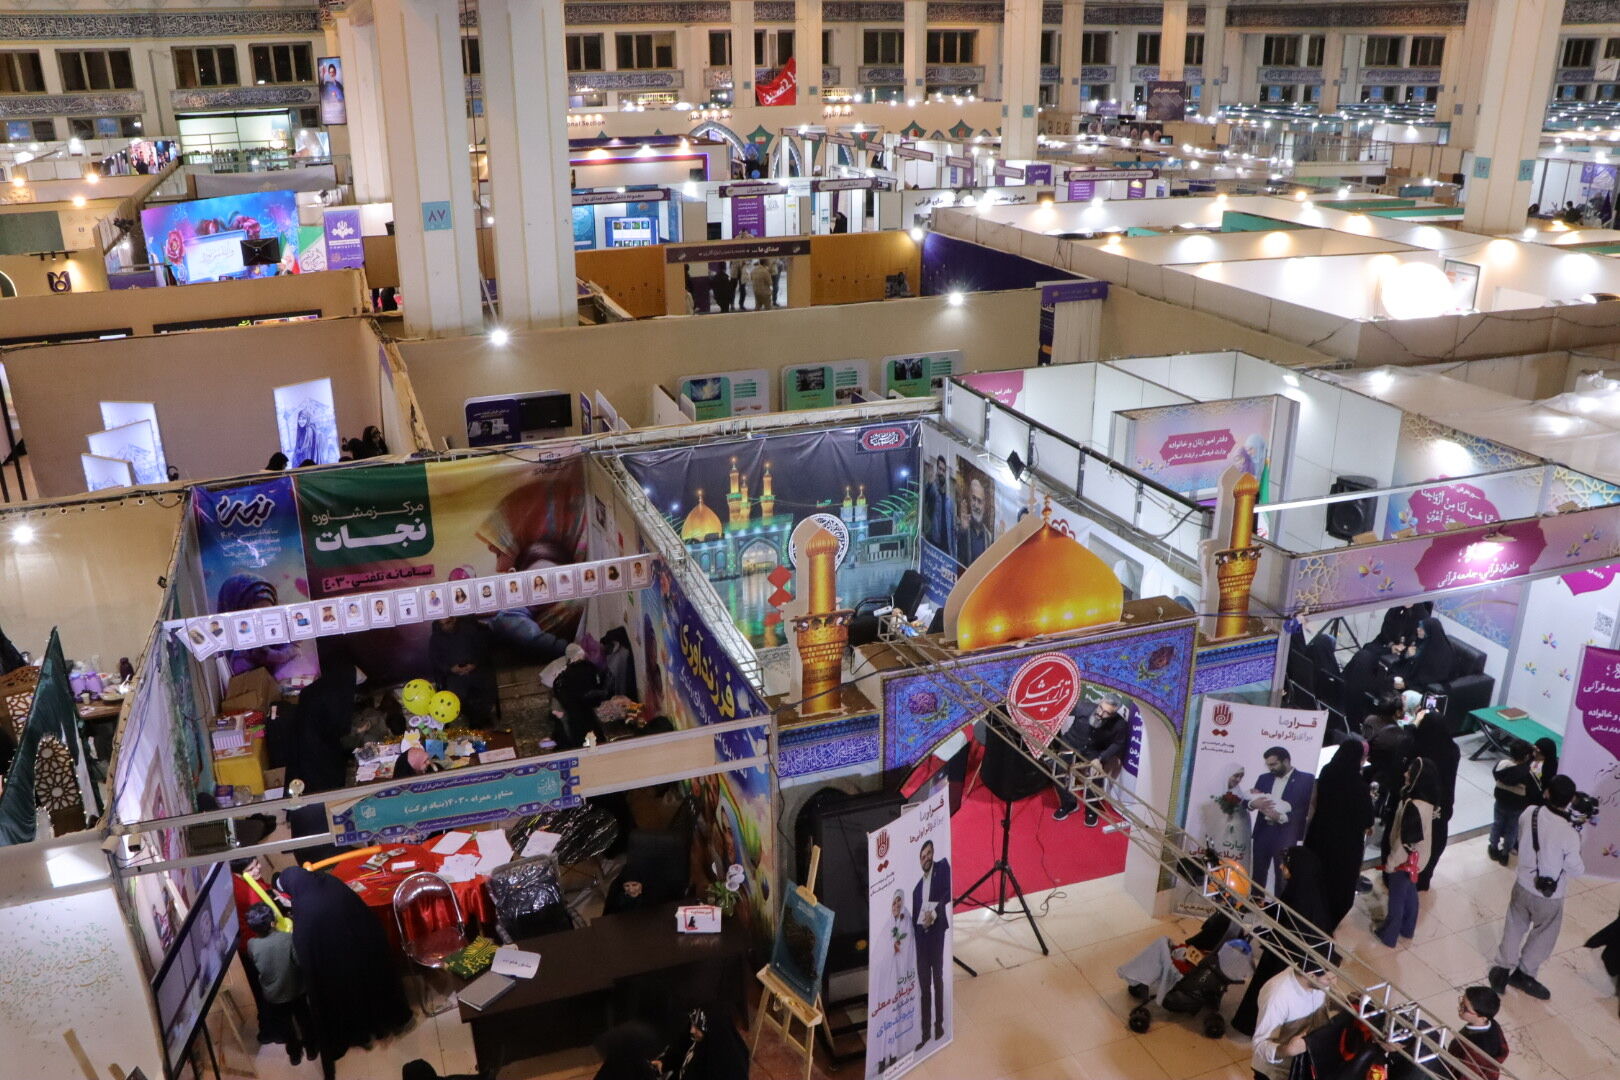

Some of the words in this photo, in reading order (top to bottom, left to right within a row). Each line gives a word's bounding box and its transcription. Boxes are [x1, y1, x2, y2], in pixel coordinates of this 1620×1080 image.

[428, 209, 446, 223] ۸۷
[315, 517, 427, 551] نجات
[385, 566, 432, 581] سامانه
